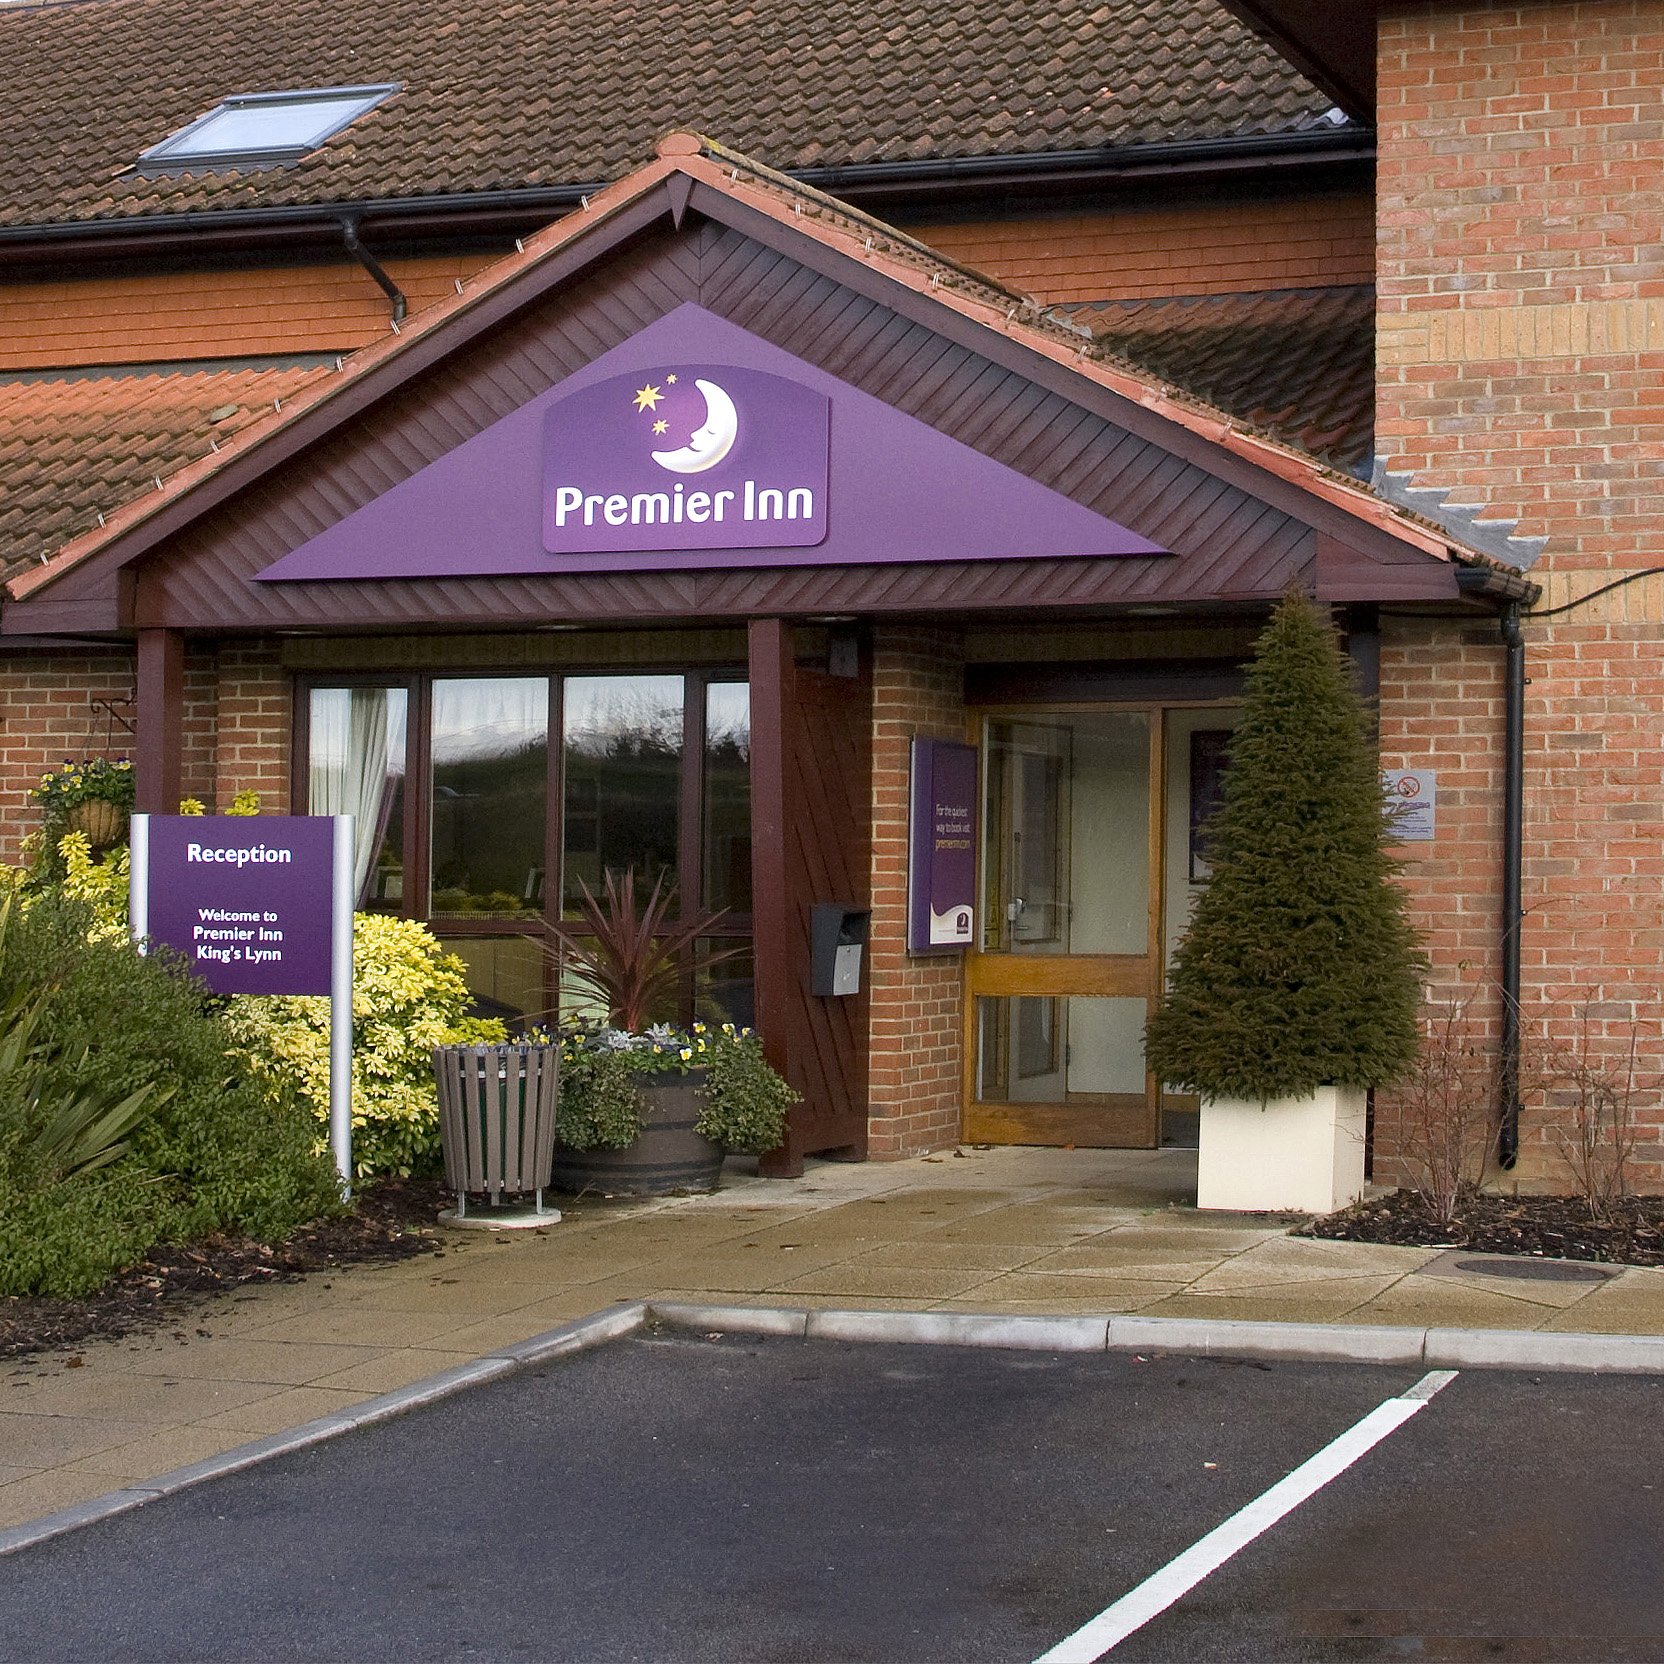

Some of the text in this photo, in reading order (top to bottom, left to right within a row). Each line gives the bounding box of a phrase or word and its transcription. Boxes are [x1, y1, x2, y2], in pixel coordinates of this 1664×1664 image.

[555, 480, 813, 527] Premier Inn
[187, 843, 292, 868] Reception
[198, 909, 278, 922] Welcome to
[193, 926, 283, 941] Premier Inn
[196, 945, 282, 964] King's Lynn
